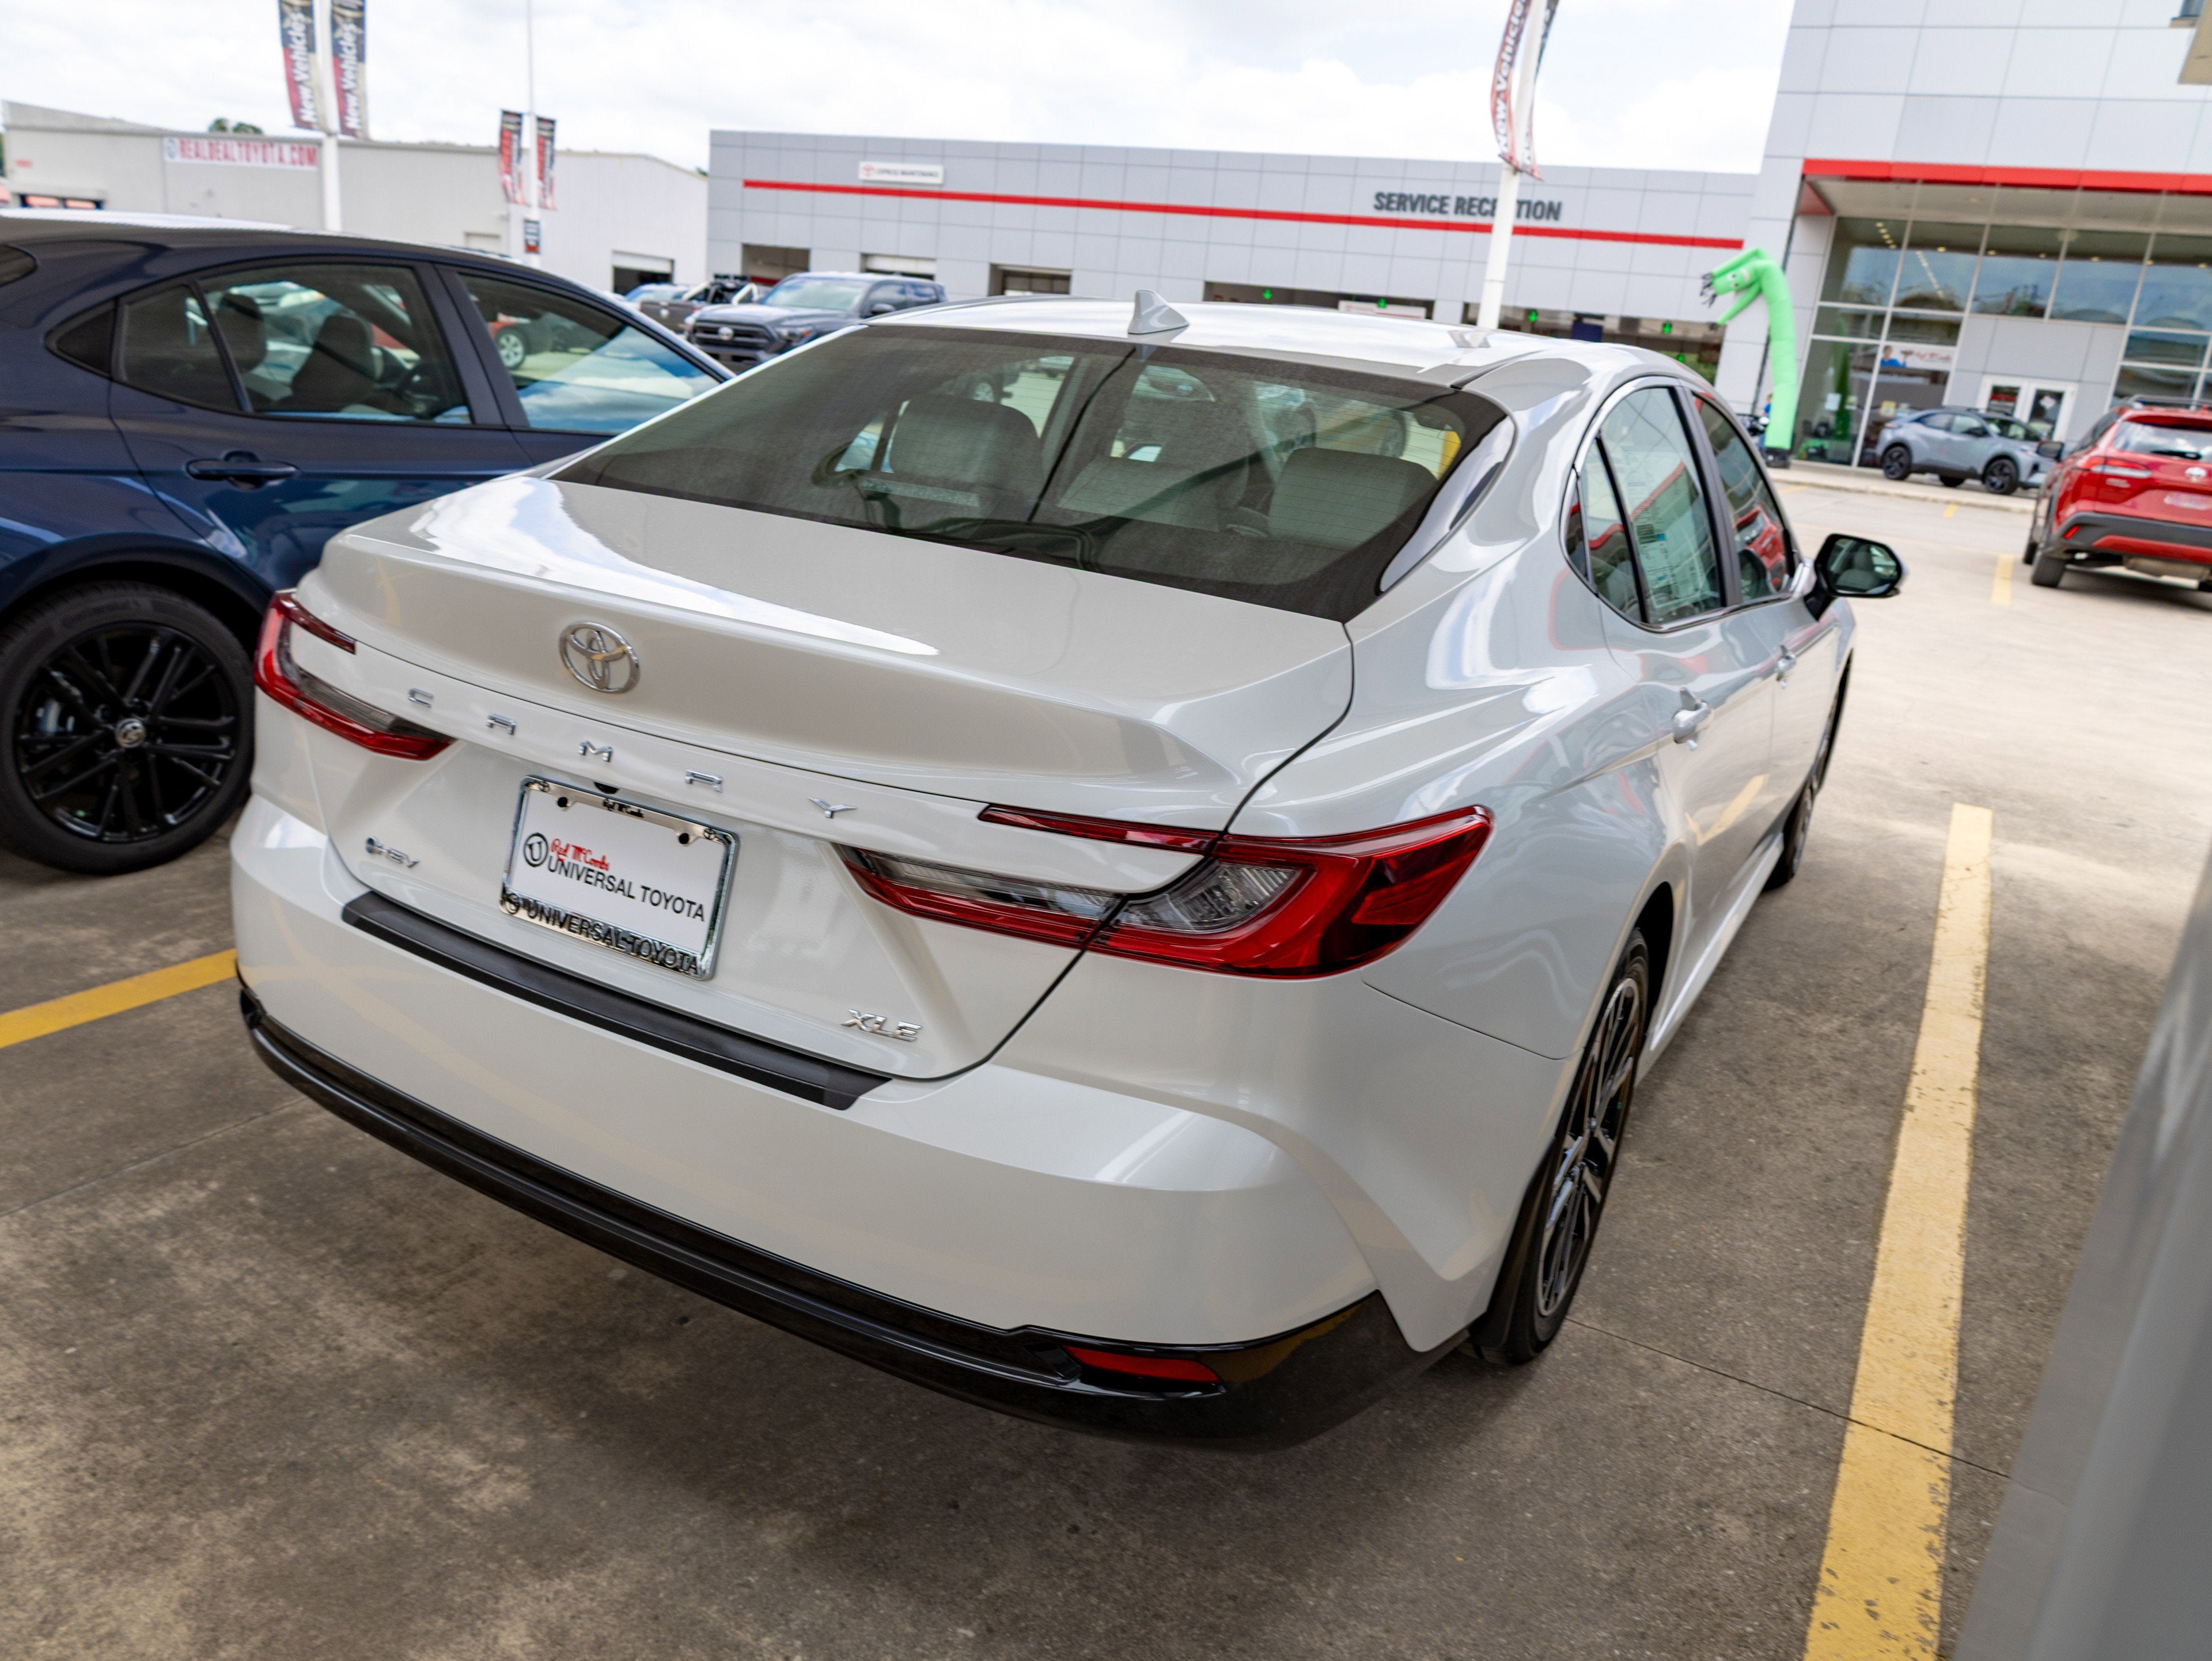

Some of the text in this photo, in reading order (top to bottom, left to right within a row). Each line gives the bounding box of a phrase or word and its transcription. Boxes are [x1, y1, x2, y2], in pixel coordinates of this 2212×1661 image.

[287, 12, 319, 123] New Vehicles
[339, 22, 361, 90] Vehicles
[345, 93, 362, 130] New
[1496, 96, 1509, 154] New
[1373, 191, 1451, 215] SERVICE
[408, 688, 858, 819] CAMRY
[548, 855, 705, 922] UNIVERSAL TOYOTA
[525, 898, 627, 951] UNIVERSAL
[629, 932, 701, 977] TOYOTA
[840, 1009, 922, 1043] XLE
